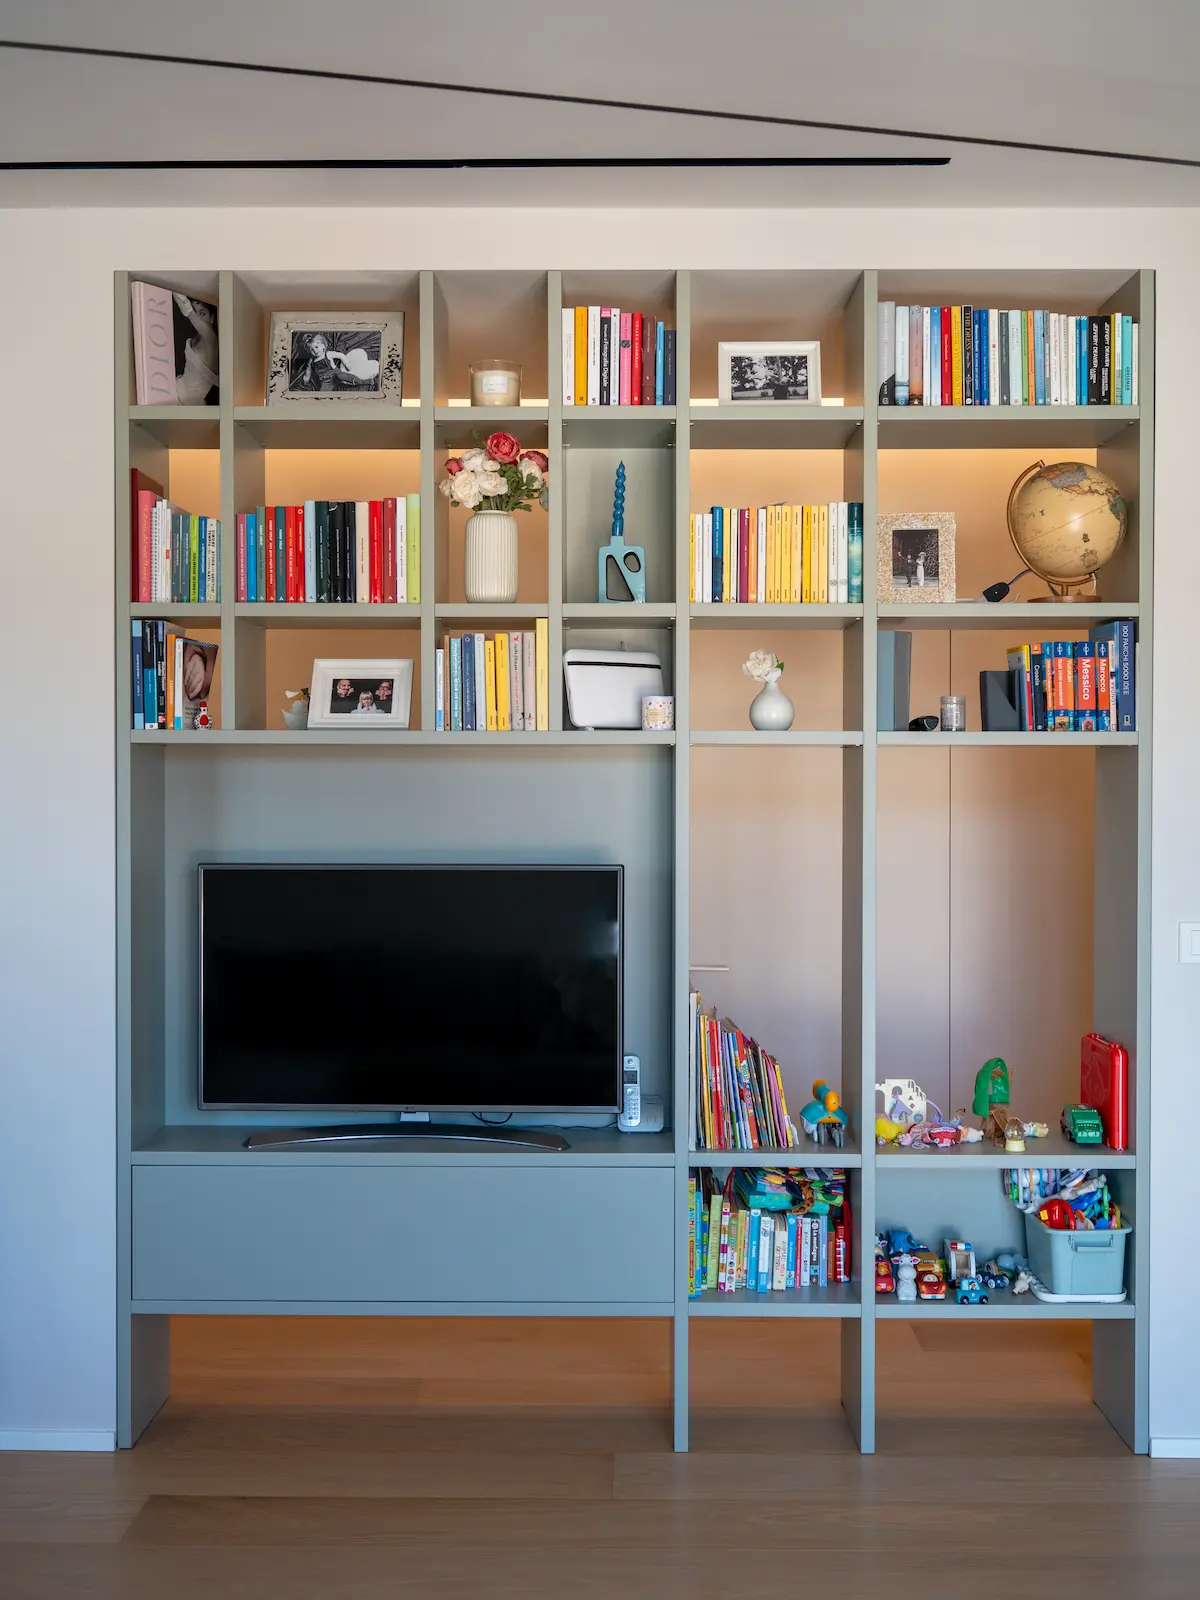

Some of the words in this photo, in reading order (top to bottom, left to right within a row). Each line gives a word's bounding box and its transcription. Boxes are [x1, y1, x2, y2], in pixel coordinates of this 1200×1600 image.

[147, 297, 170, 395] DIOR
[601, 341, 609, 367] Fotografia
[601, 367, 609, 388] Digitale
[1082, 659, 1091, 700] Messico
[1099, 659, 1107, 692] Marocco
